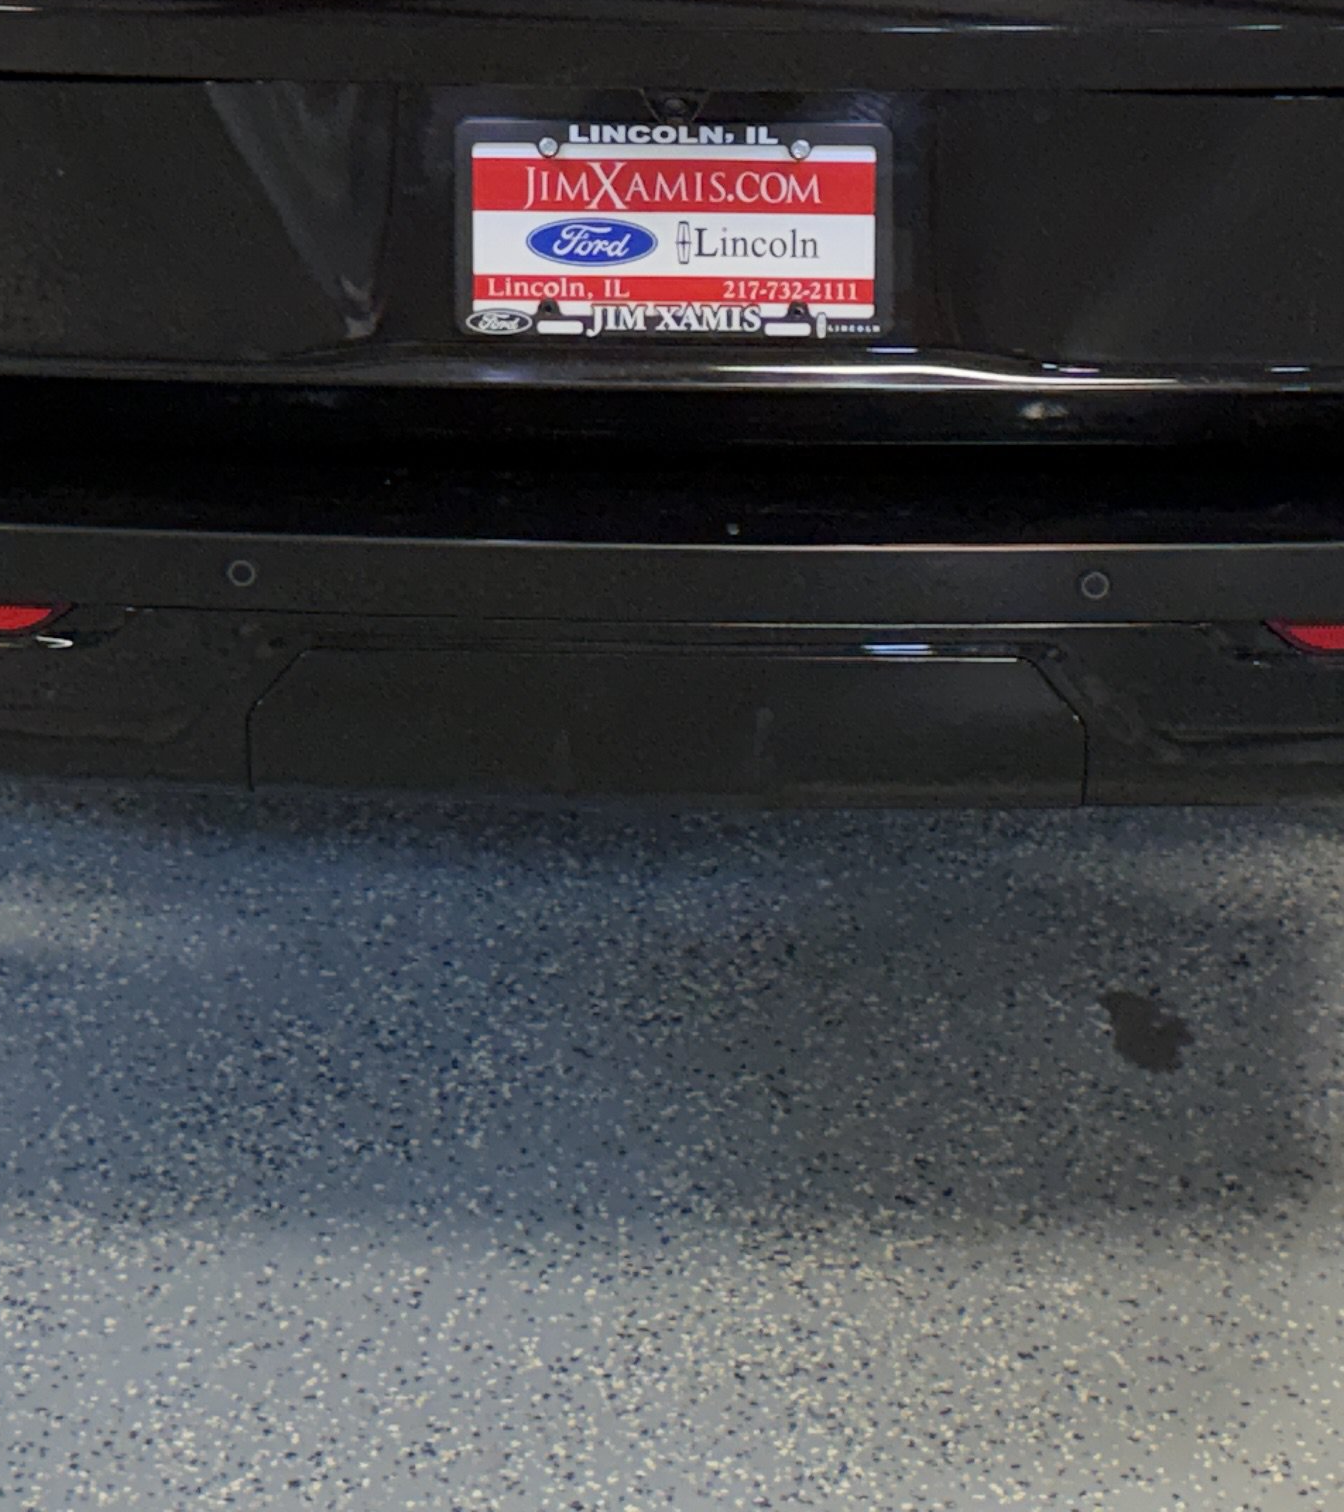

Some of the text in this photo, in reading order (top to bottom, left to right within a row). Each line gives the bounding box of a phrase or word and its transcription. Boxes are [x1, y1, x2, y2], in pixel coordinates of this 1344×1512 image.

[569, 124, 778, 145] LINCOLN, IL
[524, 162, 822, 209] JIMXAMIS.COM
[553, 223, 631, 258] Ford
[694, 227, 820, 259] Lincoln
[487, 277, 630, 299] Lincoln, IL
[722, 280, 858, 300] 217-732-2111
[476, 313, 521, 331] Ford
[587, 304, 762, 337] JIM XAMIS
[826, 324, 881, 333] LINCOLN
